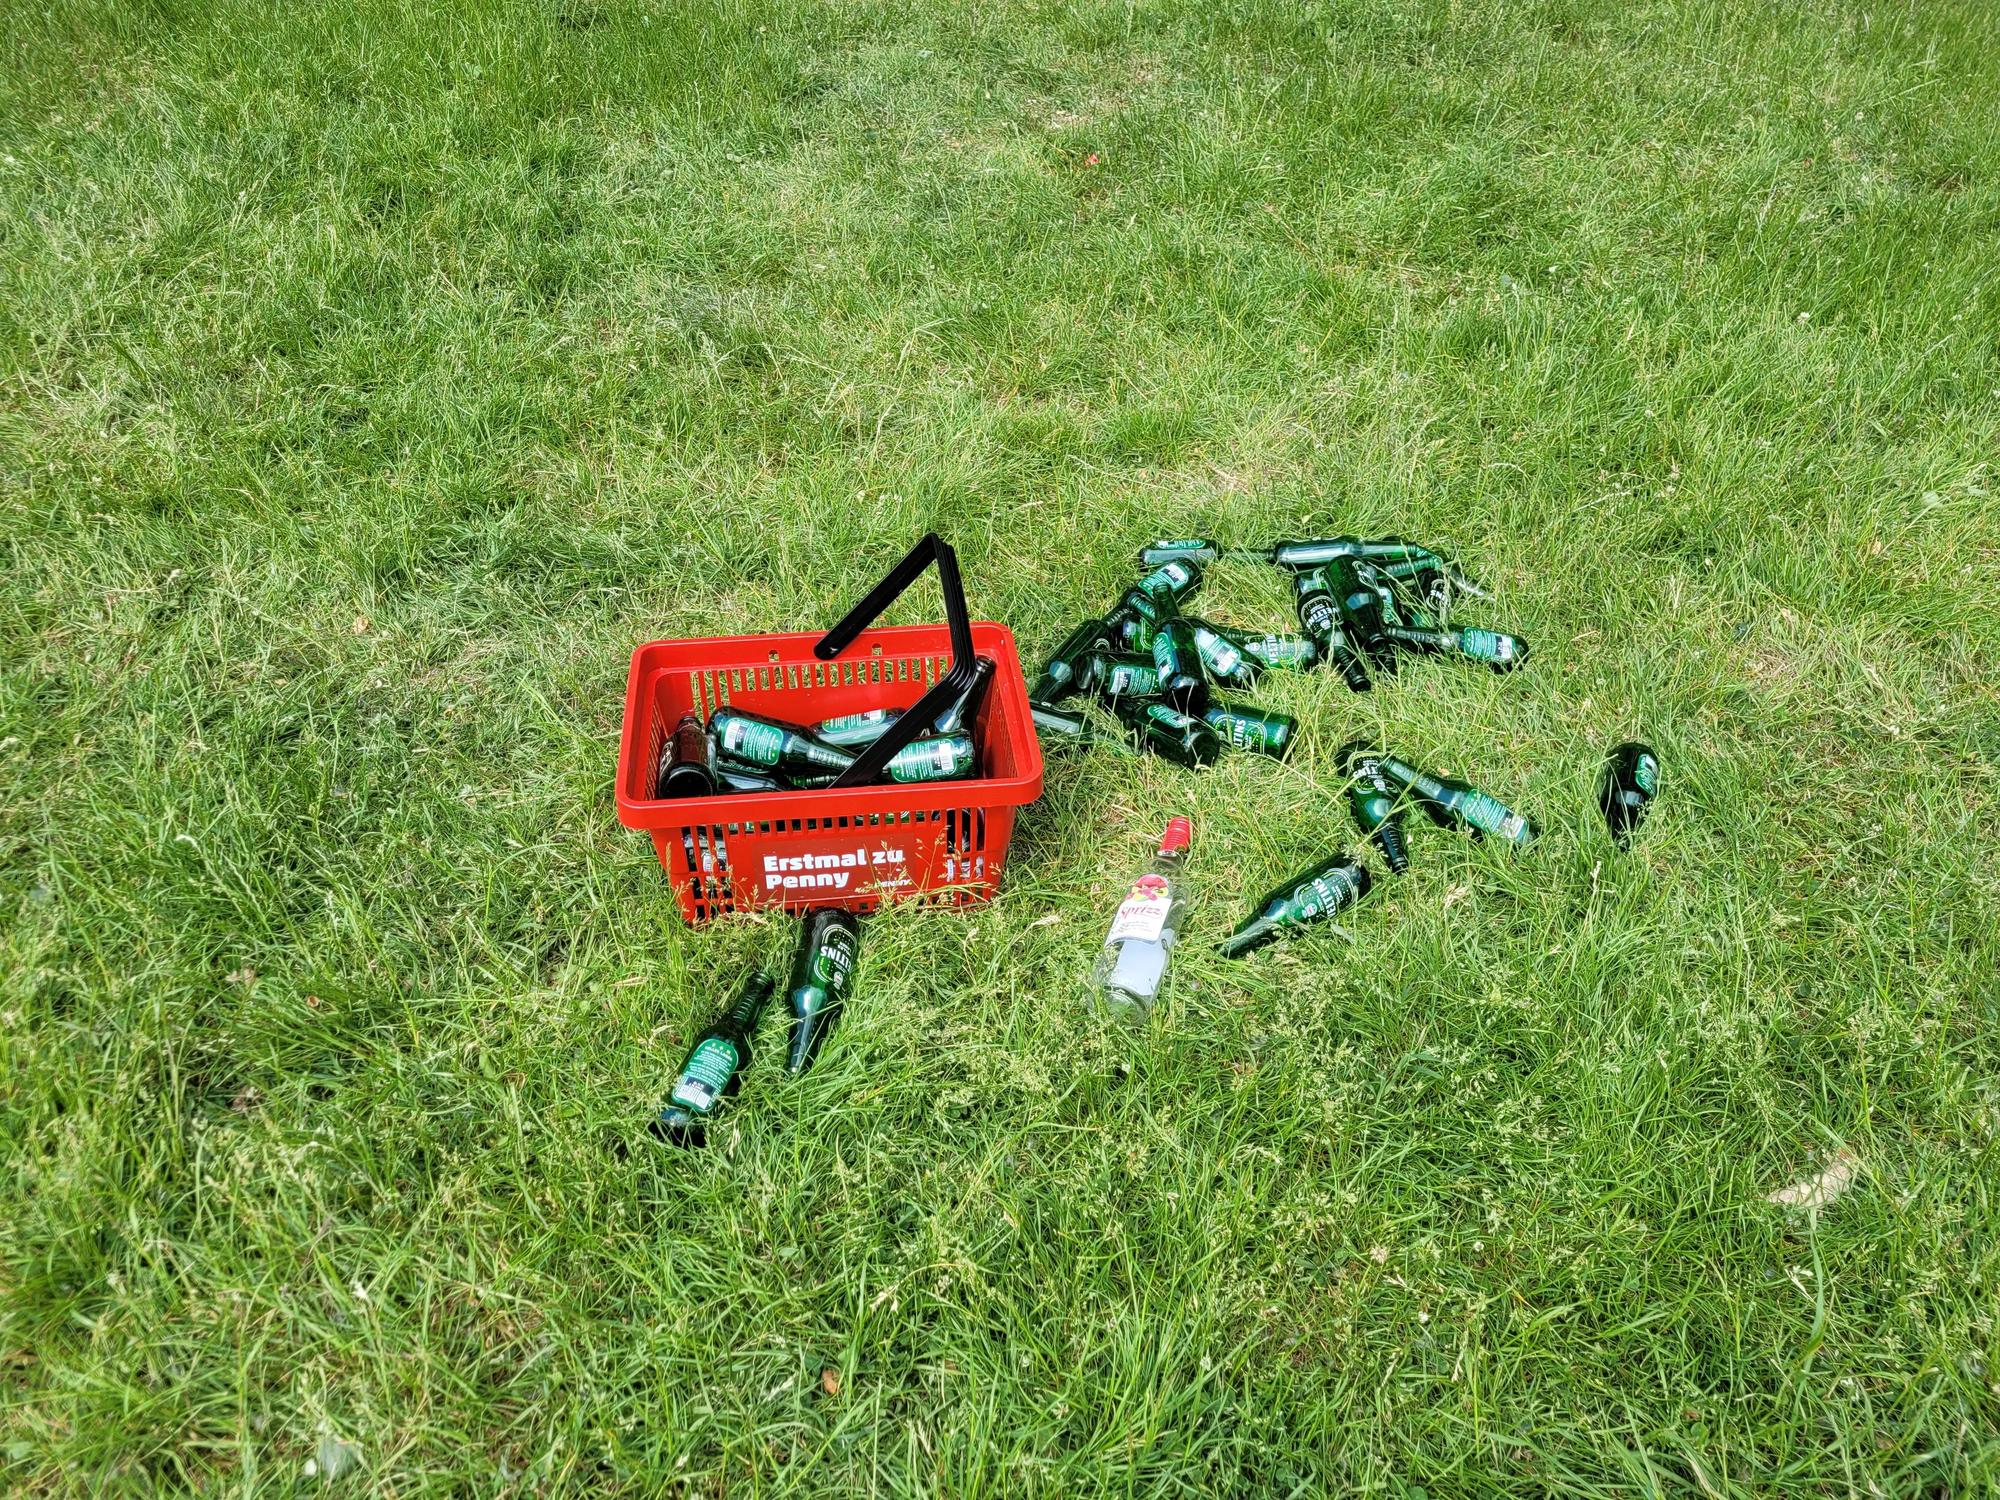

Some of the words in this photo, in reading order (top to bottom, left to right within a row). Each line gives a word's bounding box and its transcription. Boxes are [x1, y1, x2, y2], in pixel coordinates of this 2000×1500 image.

[1233, 718, 1246, 746] LTINS
[763, 849, 867, 871] Erstmal
[765, 872, 849, 890] Penny
[820, 944, 852, 972] ELTINS
